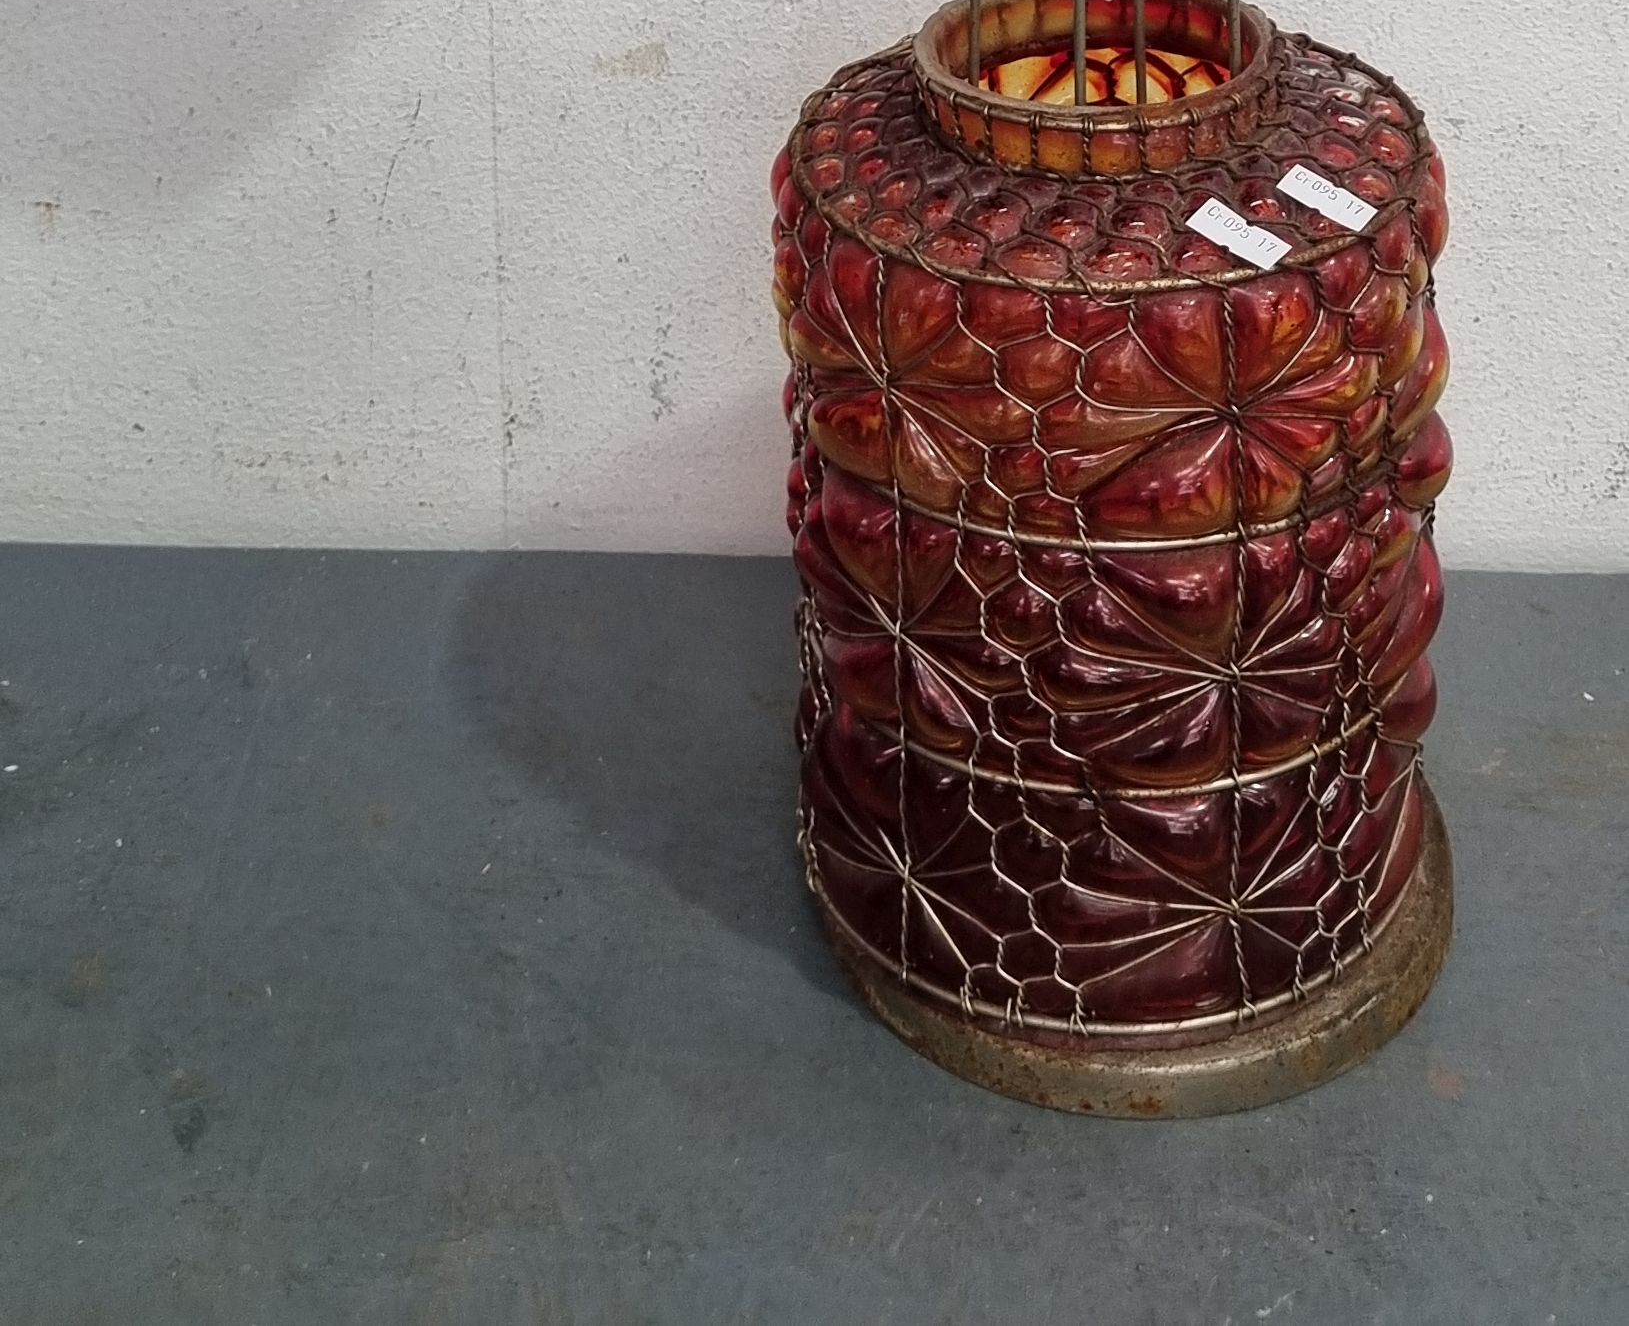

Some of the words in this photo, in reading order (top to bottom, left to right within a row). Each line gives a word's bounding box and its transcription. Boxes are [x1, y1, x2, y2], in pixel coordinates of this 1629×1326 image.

[1295, 170, 1339, 201] Cr095
[1346, 201, 1365, 215] 17
[1207, 205, 1251, 239] Cr095
[1256, 237, 1277, 252] 17
